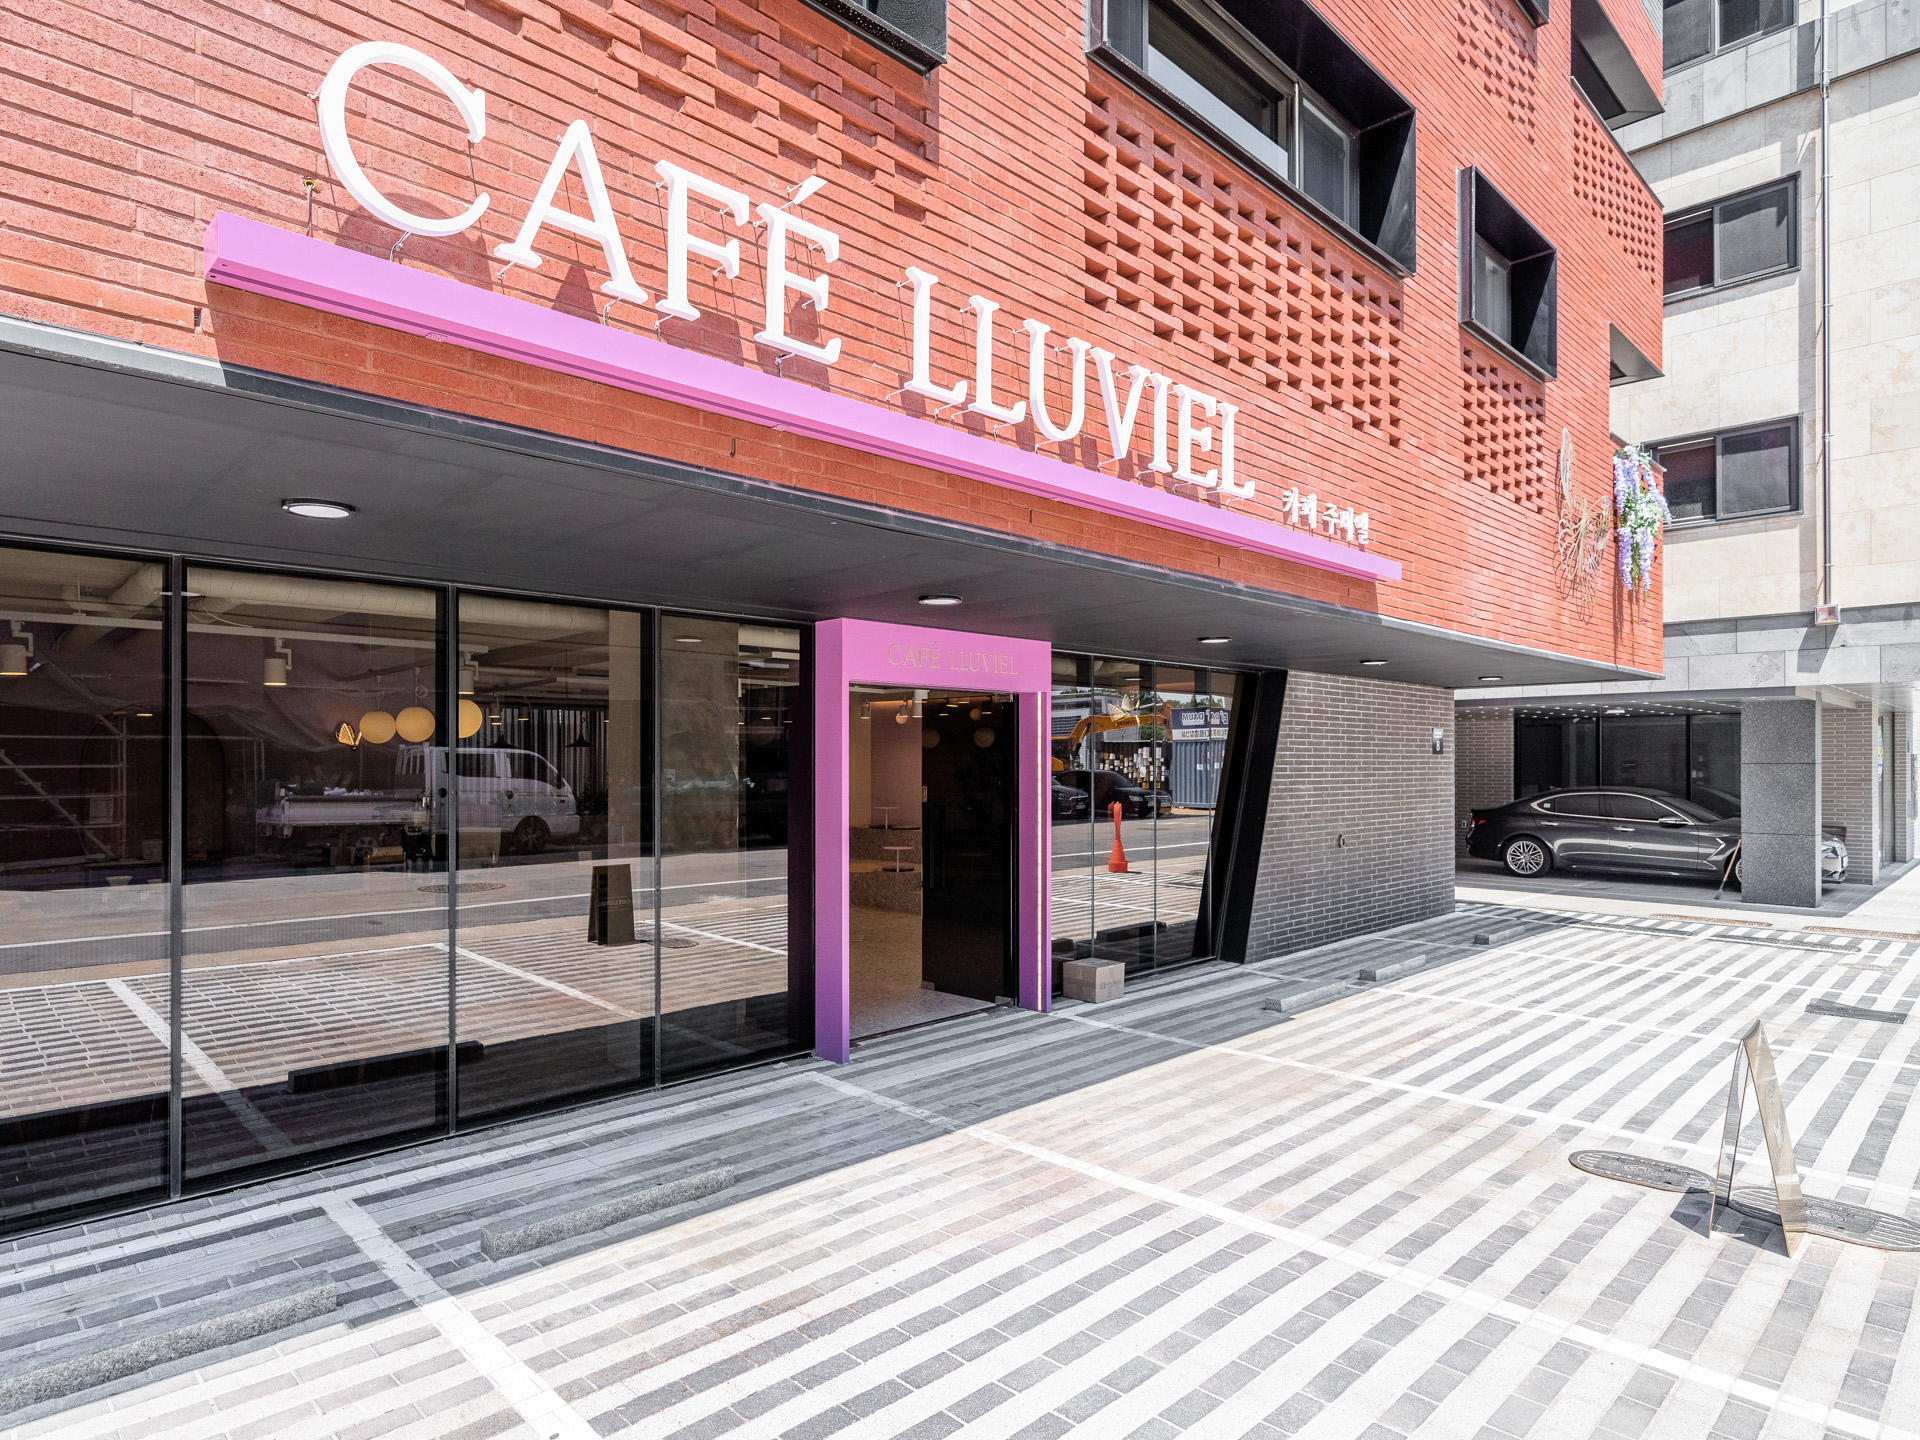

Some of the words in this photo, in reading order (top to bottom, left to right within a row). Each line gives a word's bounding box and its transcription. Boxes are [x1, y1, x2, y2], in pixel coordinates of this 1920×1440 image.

[318, 41, 842, 365] CAFÉ
[904, 266, 1256, 498] LLUVIEL
[1282, 487, 1317, 529] 카페
[888, 641, 940, 668] CAFÉ
[949, 651, 1018, 675] LLUVIEL
